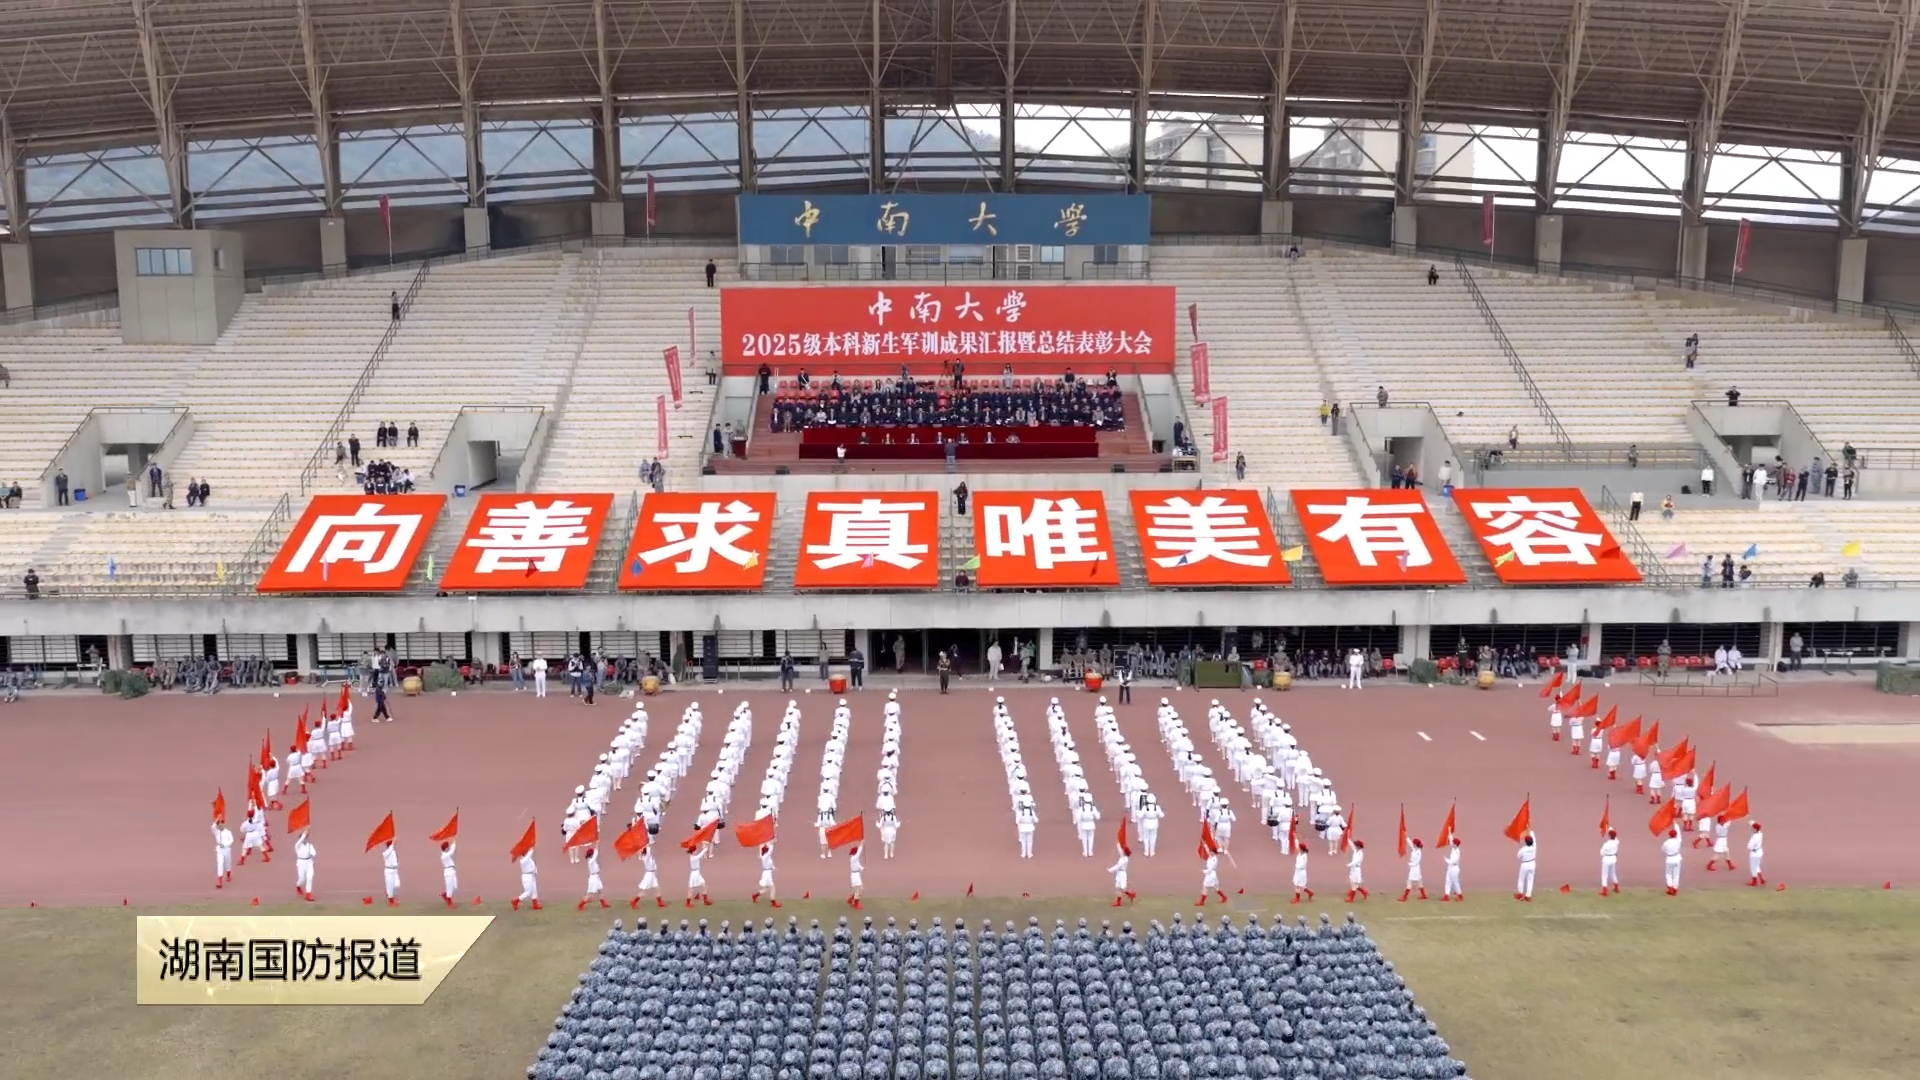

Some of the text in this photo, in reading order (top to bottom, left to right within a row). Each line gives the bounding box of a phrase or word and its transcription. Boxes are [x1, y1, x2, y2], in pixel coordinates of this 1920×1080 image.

[742, 330, 1153, 357] 2025级本科新生军训成果汇报暨总结表彰大会
